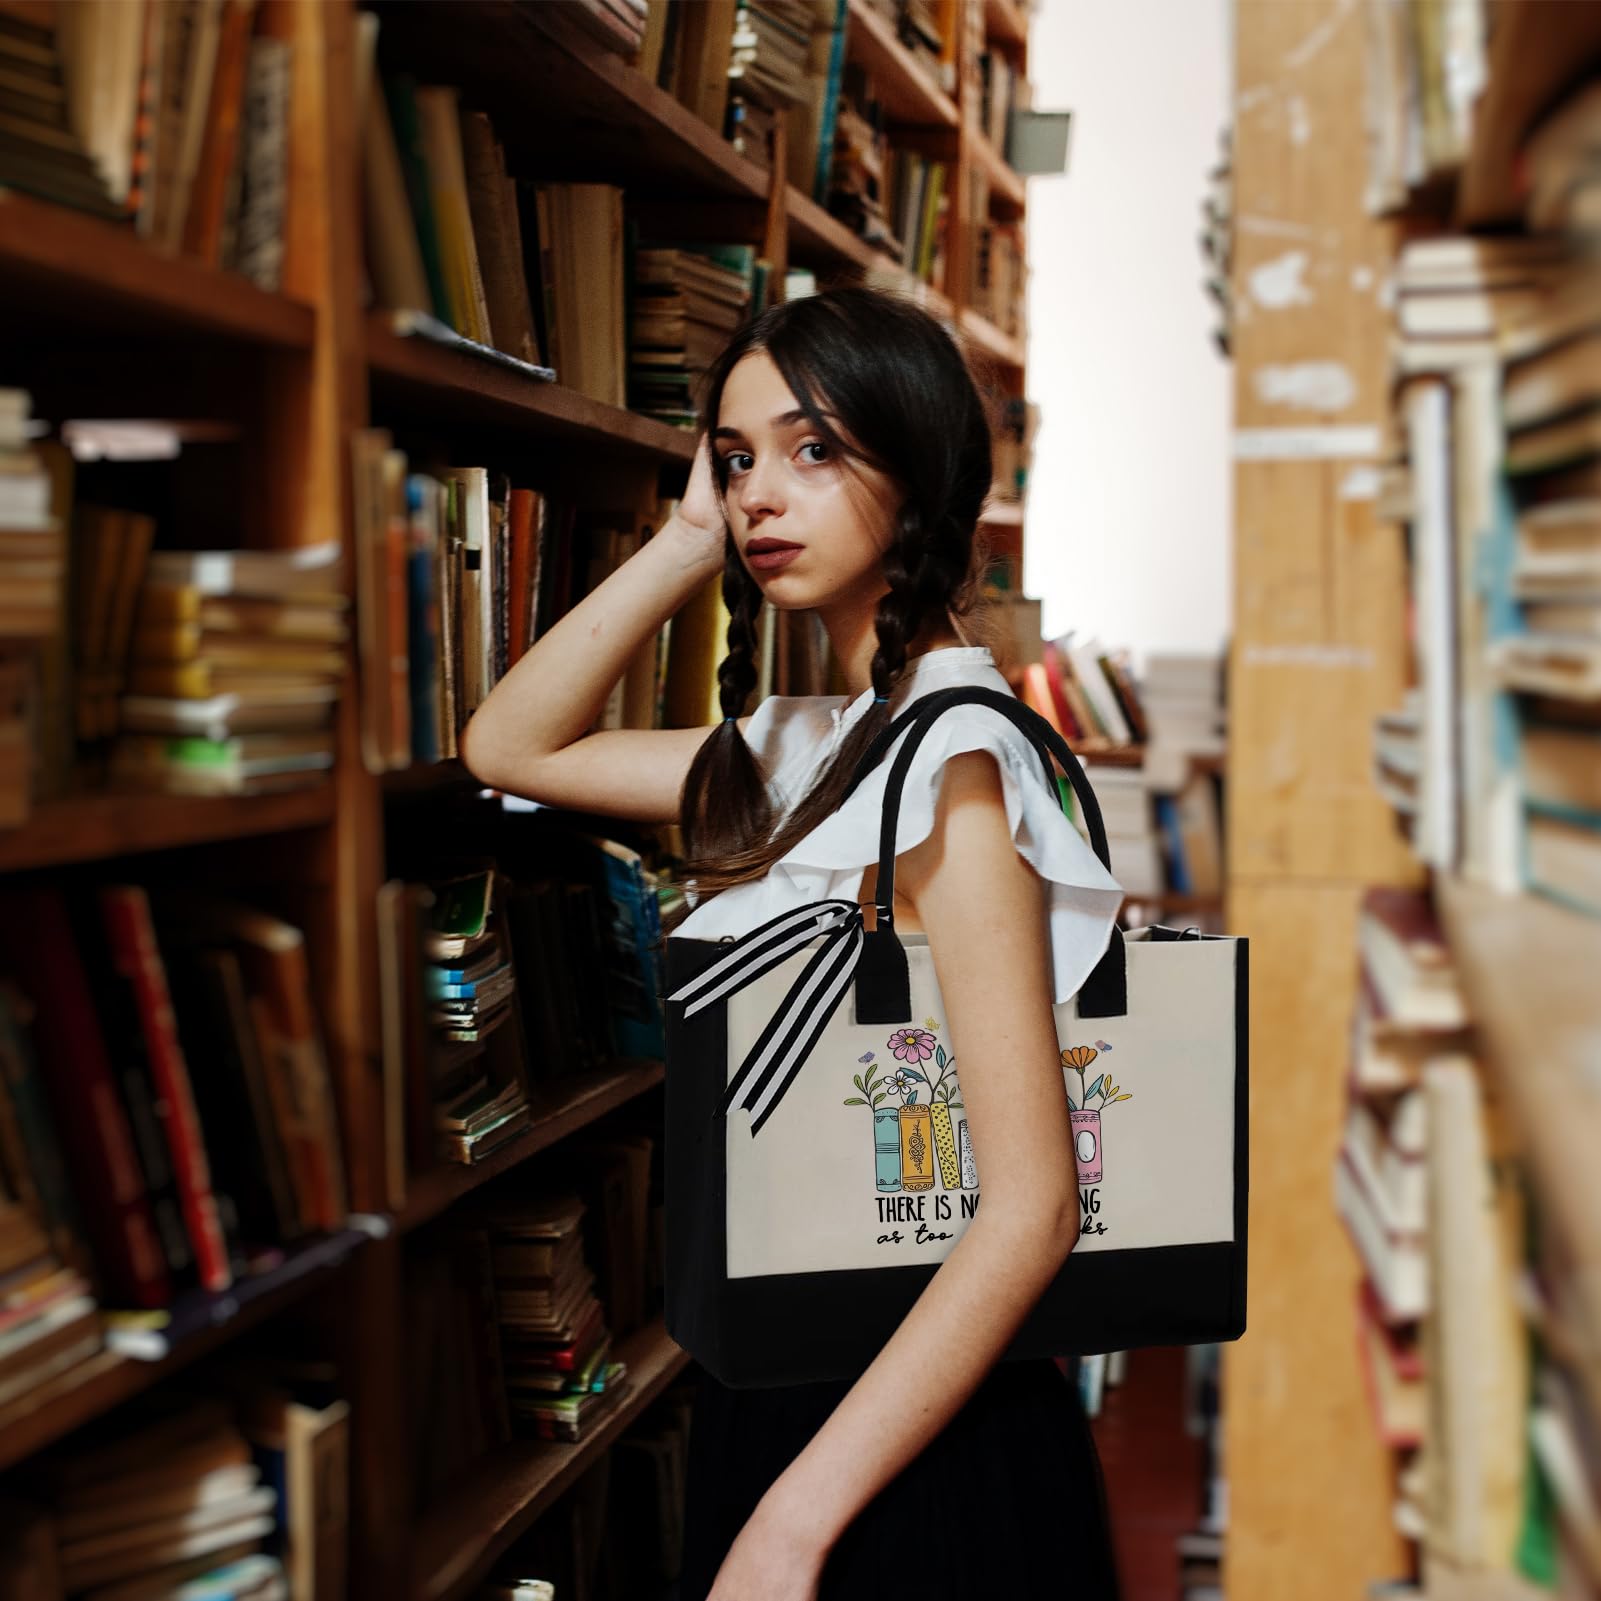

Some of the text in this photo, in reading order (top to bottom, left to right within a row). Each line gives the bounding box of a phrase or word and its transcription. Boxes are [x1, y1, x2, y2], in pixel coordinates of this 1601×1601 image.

[875, 1196, 926, 1222] THERE
[935, 1194, 951, 1220] IS
[961, 1194, 980, 1219] N
[877, 1231, 904, 1244] as
[914, 1223, 954, 1244] too
